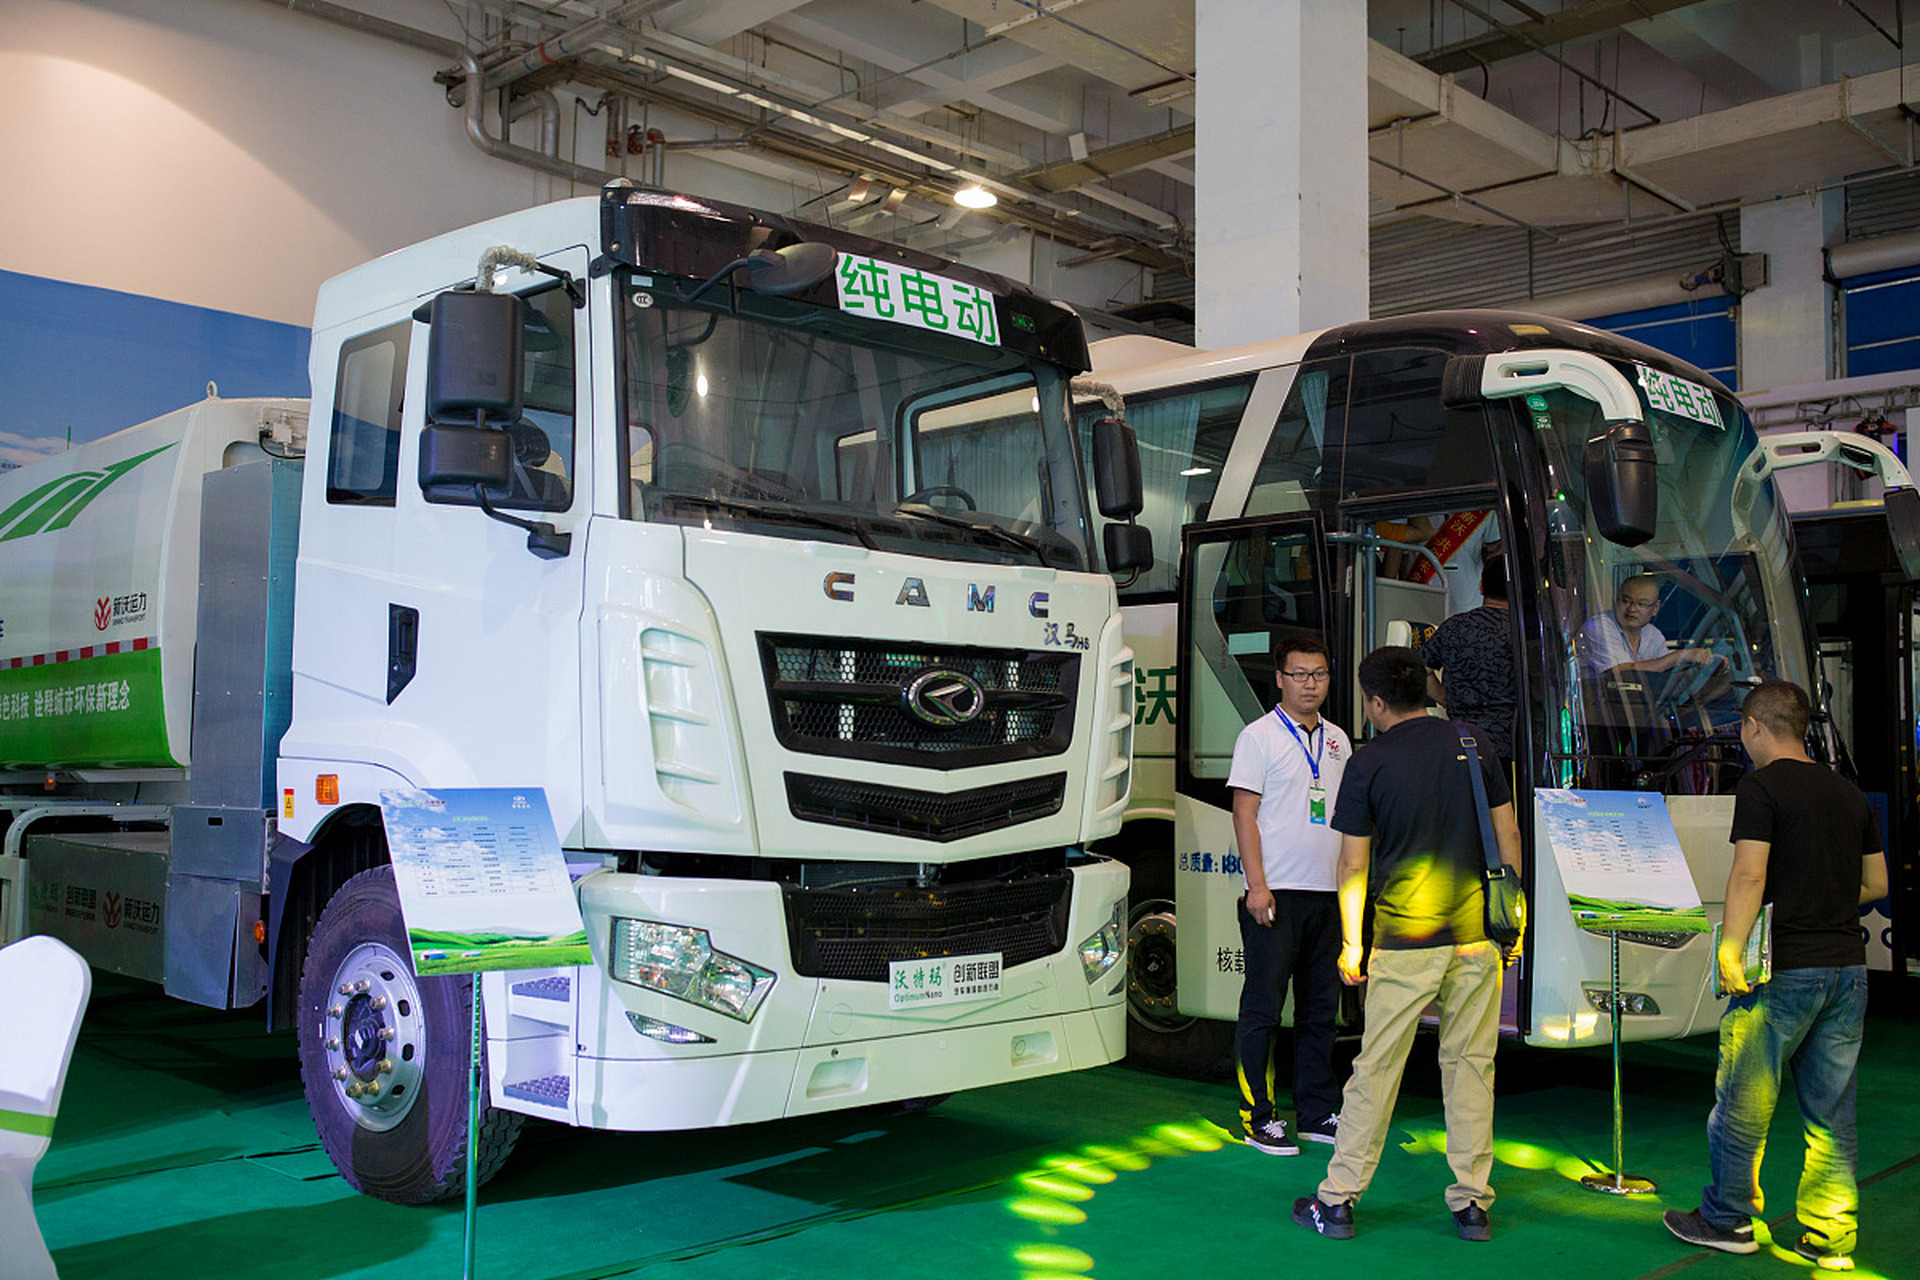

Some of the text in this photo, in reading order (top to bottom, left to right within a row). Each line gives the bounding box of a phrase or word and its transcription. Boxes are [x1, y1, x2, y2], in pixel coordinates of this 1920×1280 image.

[840, 253, 997, 344] 纯电动
[1642, 367, 1722, 426] 纯电动
[112, 591, 147, 617] 新沃运力
[823, 571, 1050, 618] CAMC
[34, 679, 131, 718] 诠释城市环保新理念
[1135, 666, 1177, 725] 沃
[124, 897, 160, 925] 新沃运力
[894, 966, 943, 991] 沃特玛
[954, 960, 1000, 984] 创新联盟
[894, 990, 943, 1004] OptimumNano
[1309, 1202, 1325, 1234] FILA
